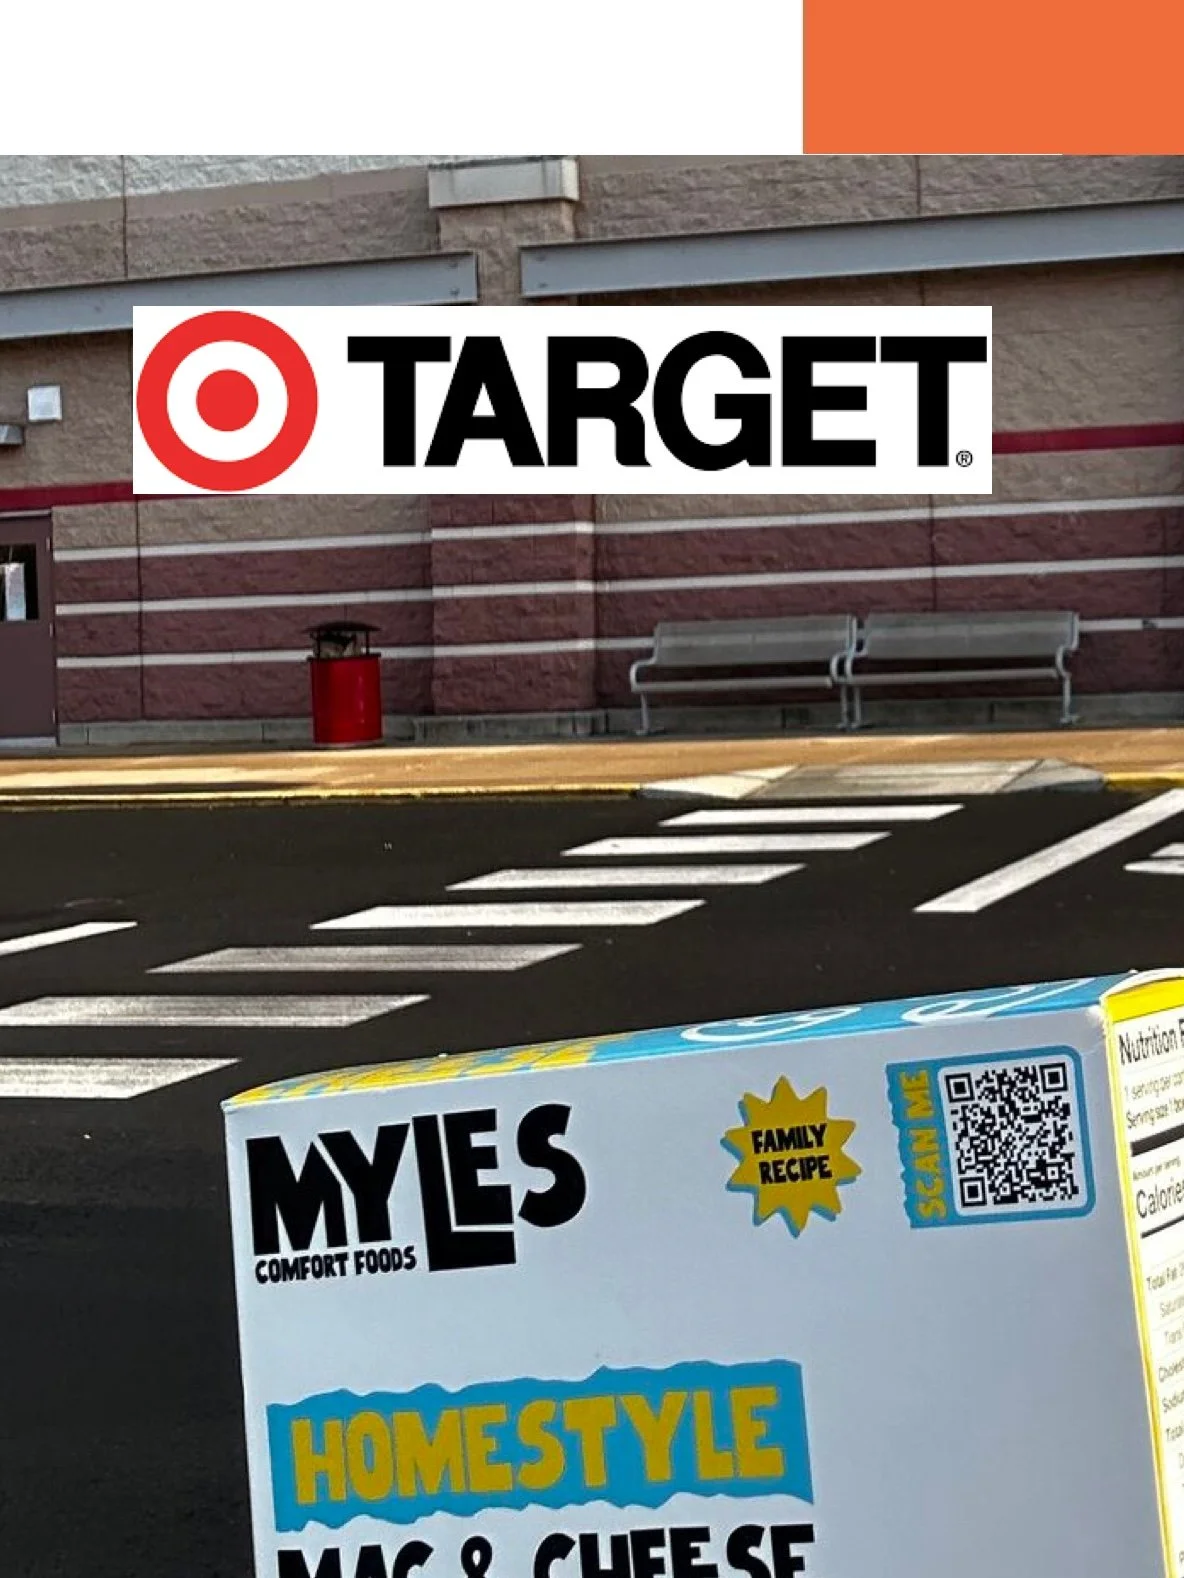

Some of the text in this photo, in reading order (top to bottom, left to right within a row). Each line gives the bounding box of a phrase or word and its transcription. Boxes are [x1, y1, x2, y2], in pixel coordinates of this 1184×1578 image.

[1118, 1023, 1178, 1066] Nutrition
[751, 1122, 828, 1155] FAMILY
[901, 1068, 948, 1221] SCAN ME
[245, 1103, 587, 1272] MYLES
[758, 1154, 833, 1185] RECIPE
[254, 1245, 418, 1285] COMFORT FOODS
[290, 1385, 786, 1505] HOMESTYLE
